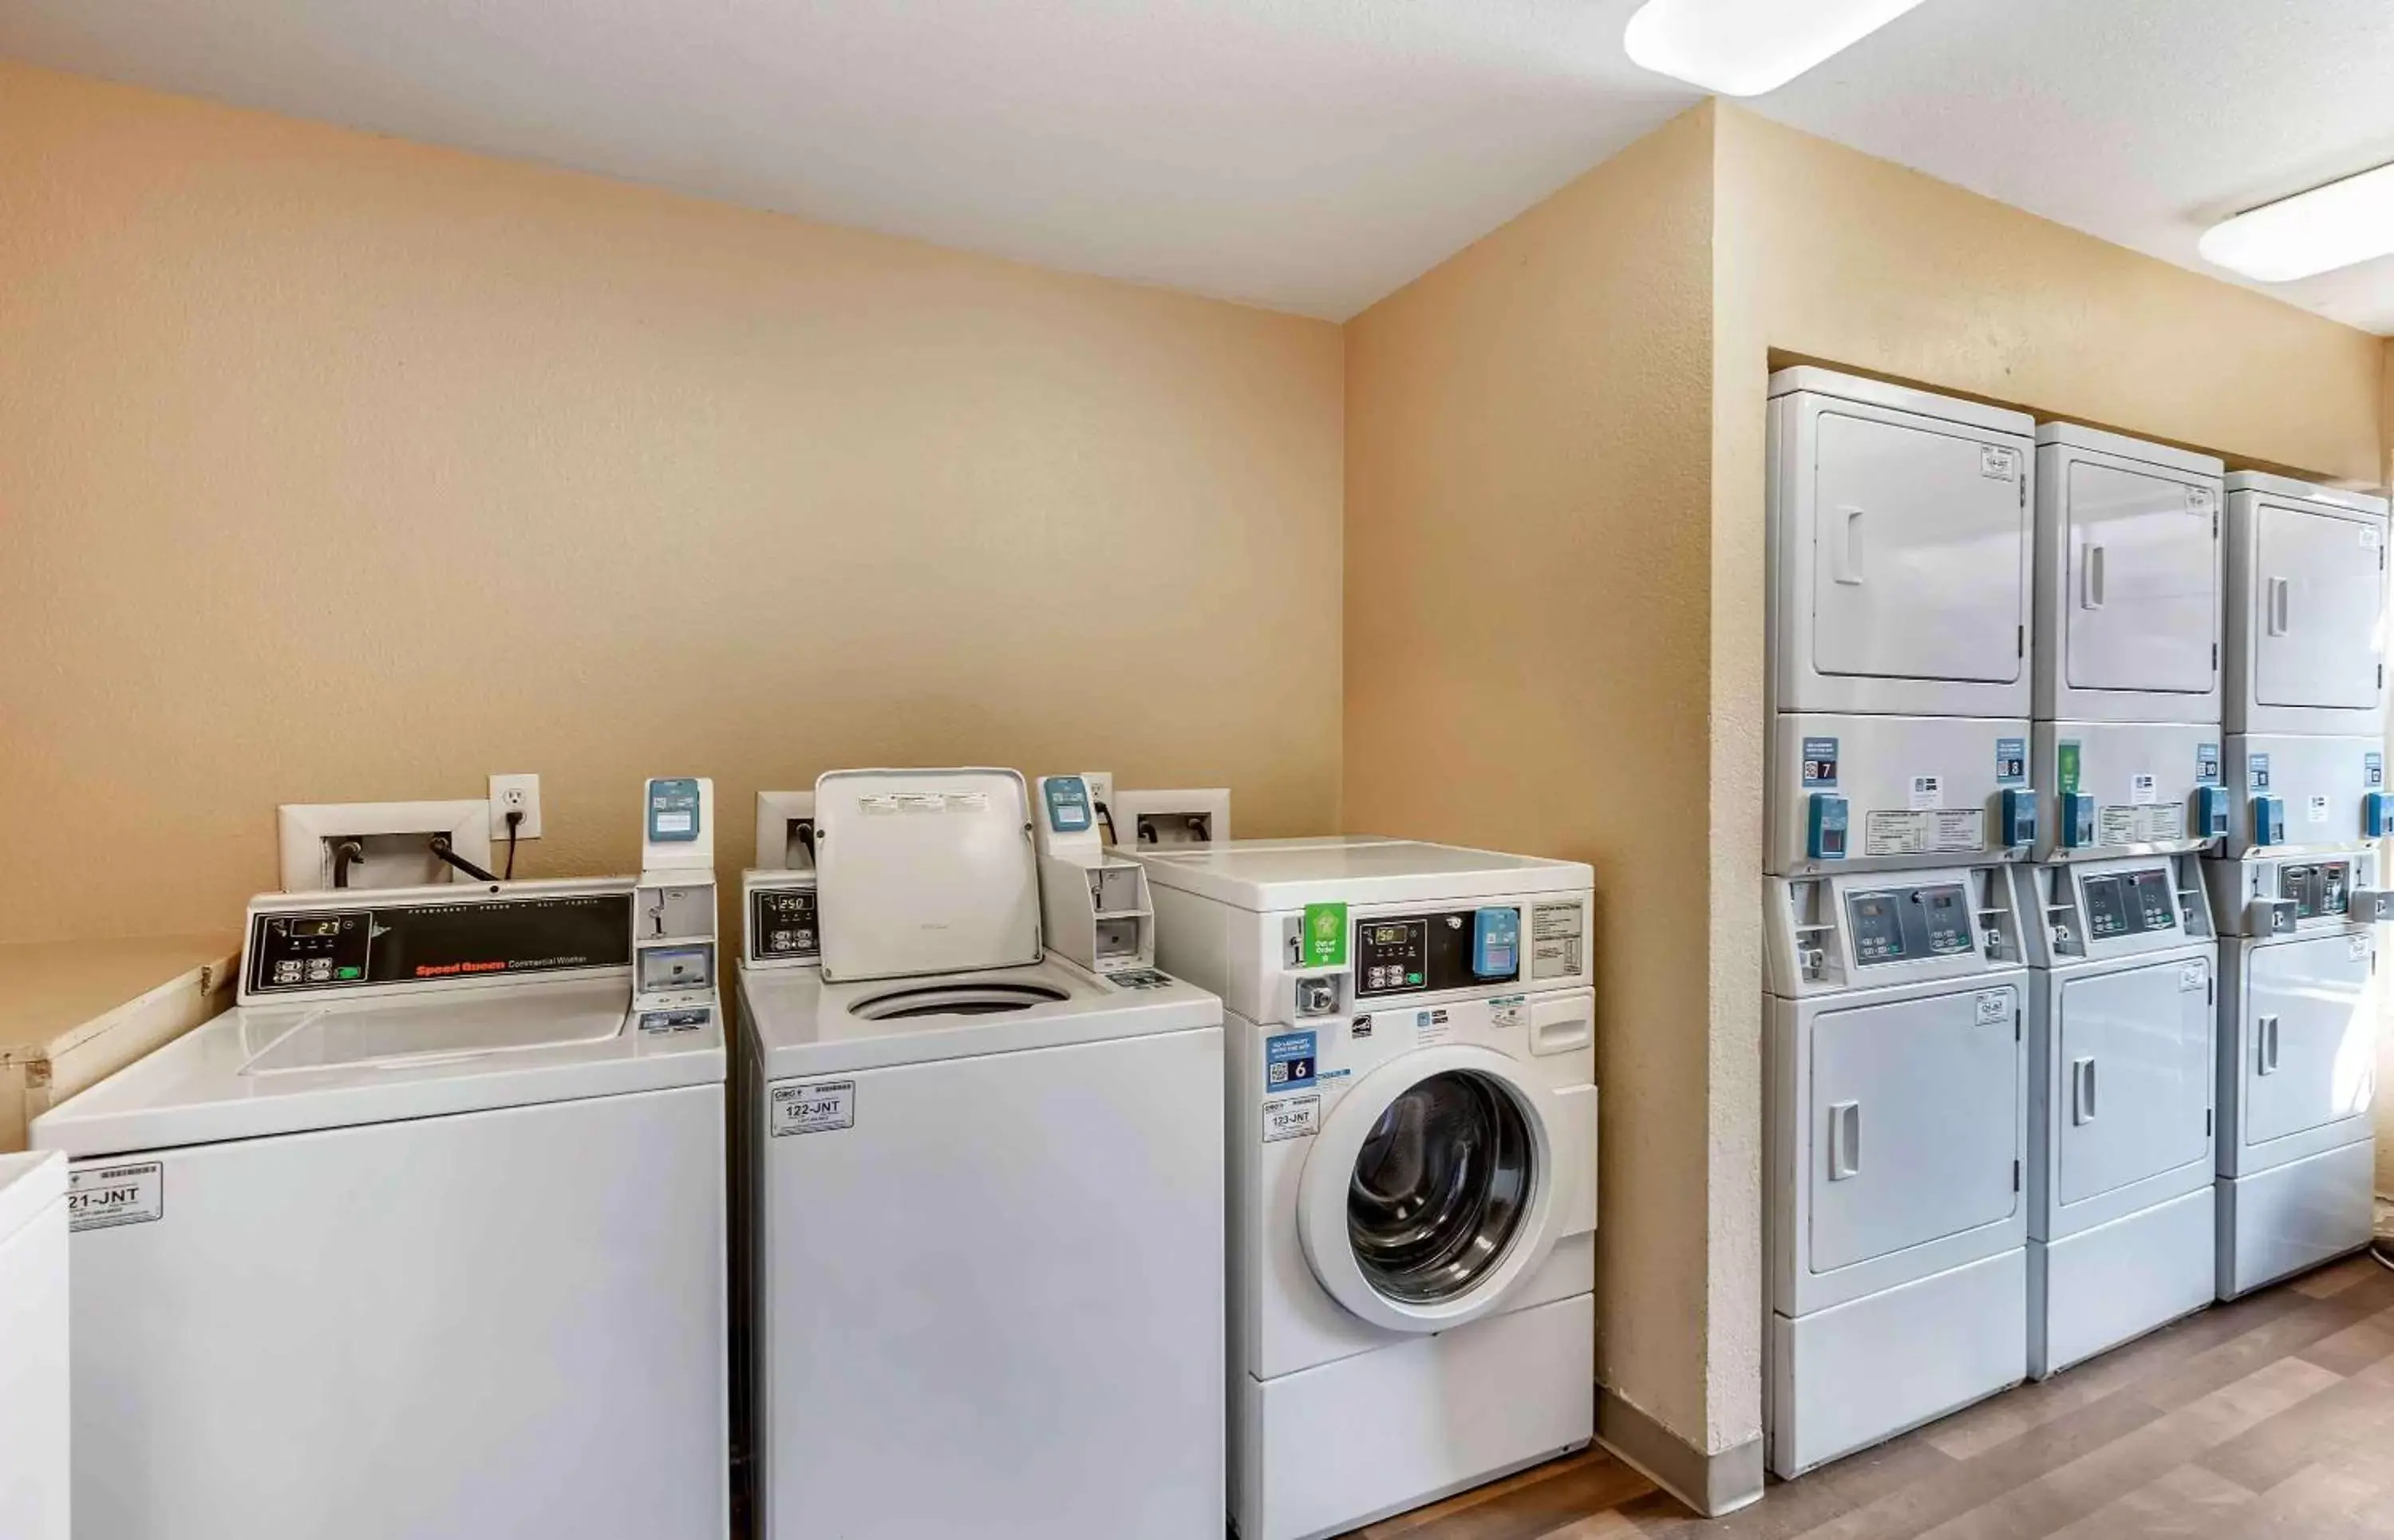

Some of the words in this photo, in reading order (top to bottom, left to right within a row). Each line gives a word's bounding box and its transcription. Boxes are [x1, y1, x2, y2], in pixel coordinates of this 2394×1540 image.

[1822, 764, 1831, 777] 7
[2012, 761, 2018, 774] 8
[780, 898, 804, 909] 250
[318, 921, 339, 935] 27
[415, 962, 460, 977] Speed
[462, 960, 506, 972] Queen
[508, 956, 556, 969] Commercial
[556, 956, 587, 965] Washer
[1295, 1060, 1306, 1078] 6
[786, 1100, 840, 1116] 122-JNT
[1273, 1112, 1310, 1126] 123-JNT
